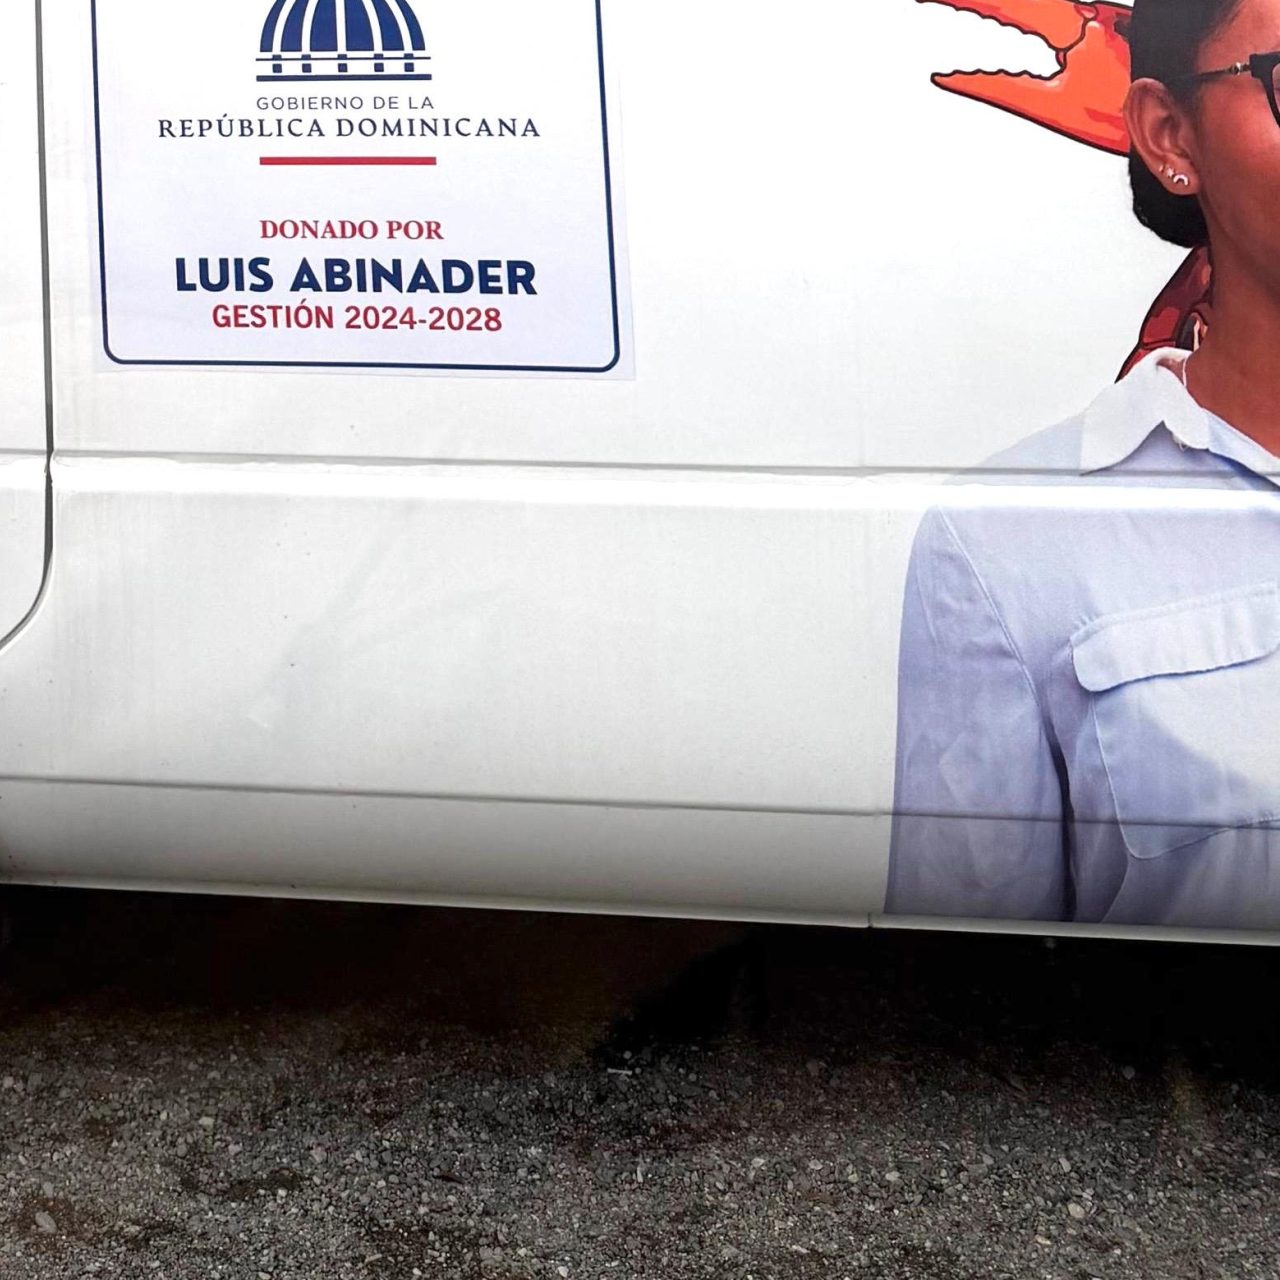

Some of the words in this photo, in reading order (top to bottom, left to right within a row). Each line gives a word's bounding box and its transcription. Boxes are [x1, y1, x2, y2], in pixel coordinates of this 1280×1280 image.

[256, 96, 364, 111] GOBIERNO
[373, 96, 399, 110] DE
[408, 96, 434, 110] LA
[158, 113, 325, 138] REPÚBLICA
[336, 118, 541, 138] DOMINICANA
[260, 220, 378, 240] DONADO
[387, 221, 444, 240] POR
[175, 258, 273, 291] LUIS
[290, 258, 537, 295] ABINADER
[212, 299, 334, 329] GESTIÓN
[345, 306, 503, 332] 2024-2028
